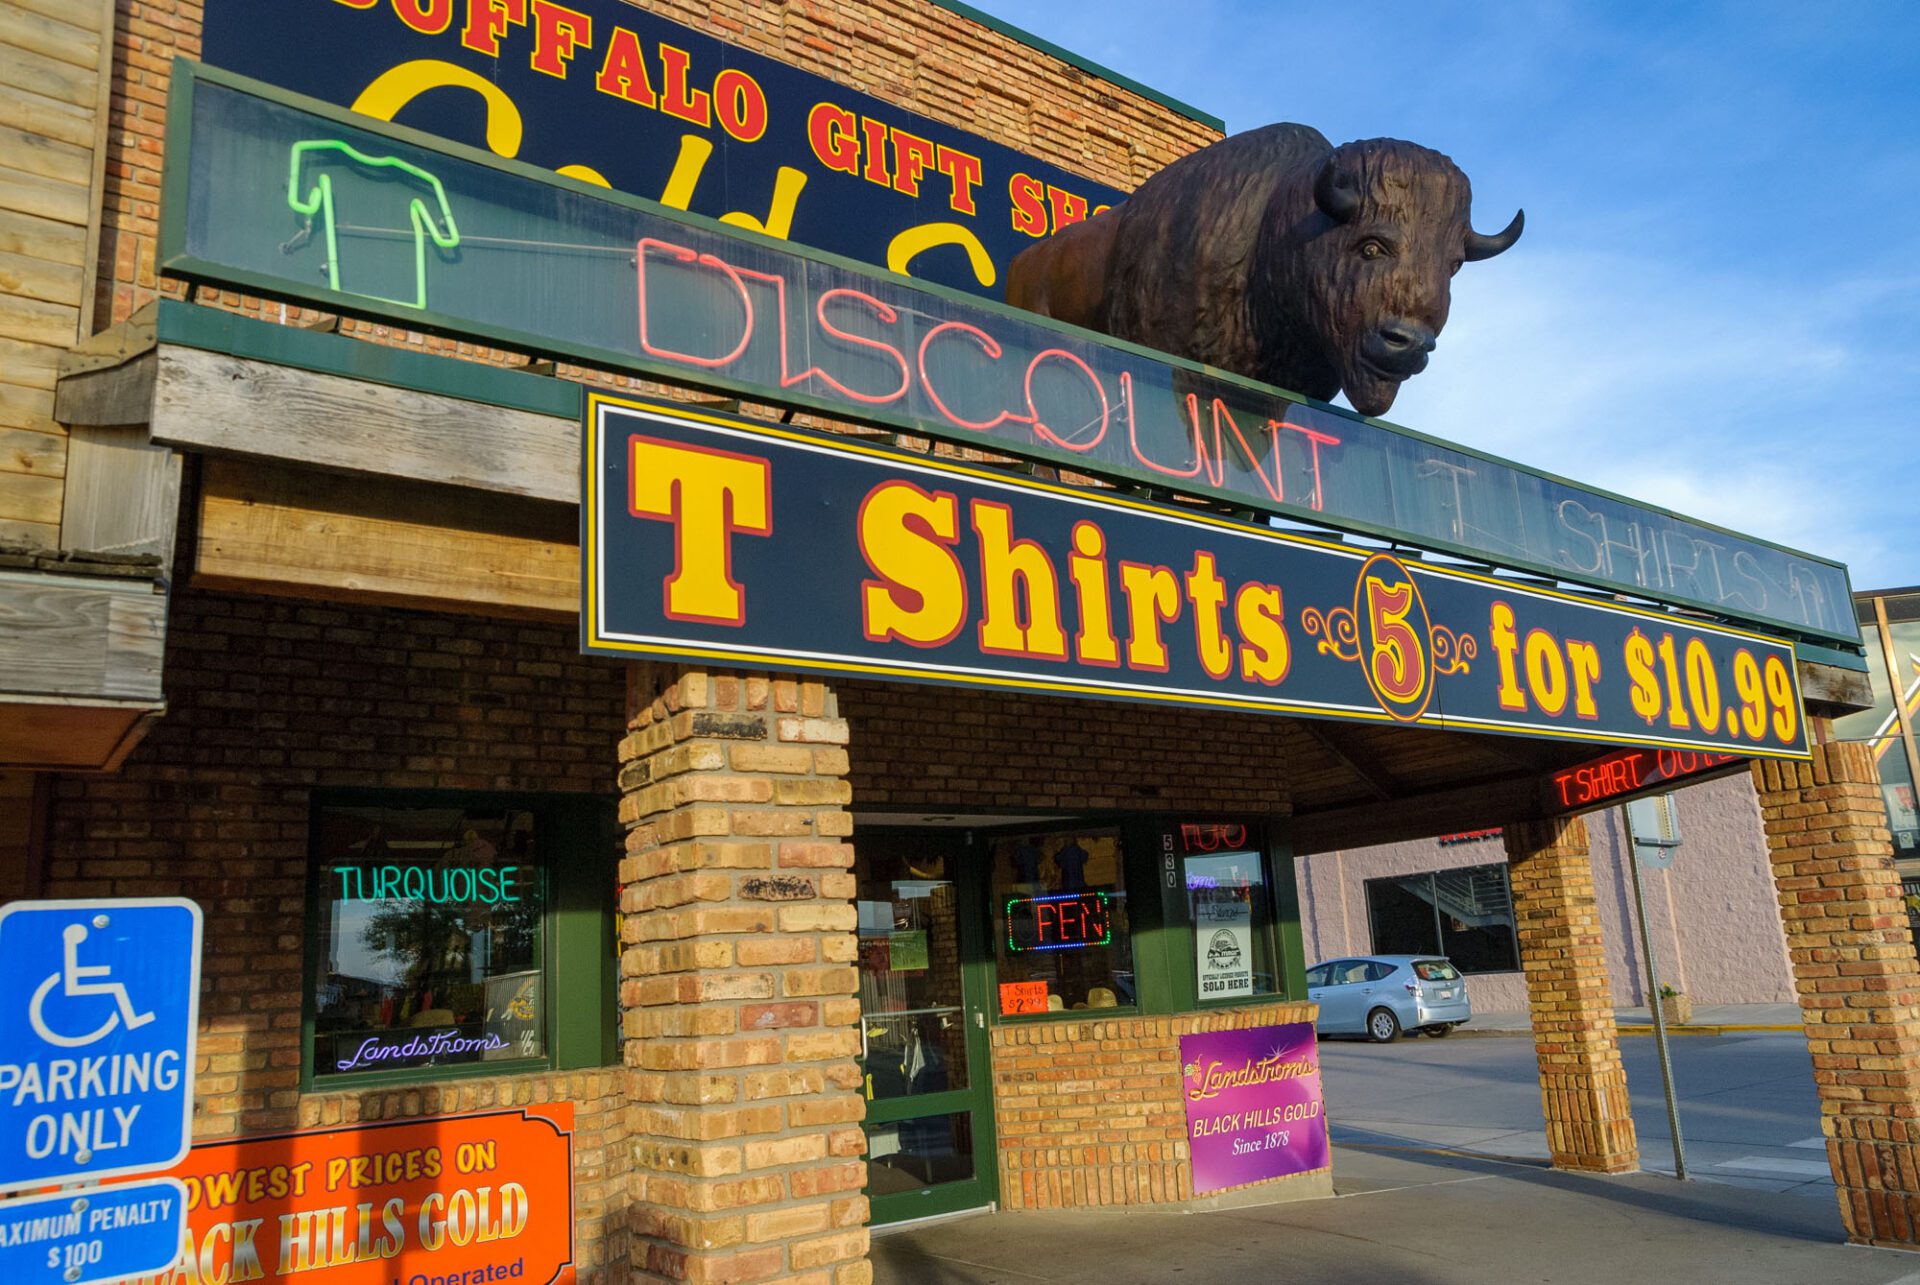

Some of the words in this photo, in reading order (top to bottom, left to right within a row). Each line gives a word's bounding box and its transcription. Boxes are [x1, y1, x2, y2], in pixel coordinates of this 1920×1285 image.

[333, 0, 769, 143] FFALO
[807, 101, 983, 216] GIFT
[1009, 171, 1114, 238] SH
[637, 237, 1342, 512] DISCOUNT
[1417, 459, 1477, 541] T
[1556, 499, 1768, 612] SHIRTS
[628, 433, 772, 628] T
[857, 479, 1291, 687] Shirts
[1366, 575, 1425, 705] 5
[1491, 600, 1601, 721] for
[1623, 626, 1797, 745] $10.99
[1556, 775, 1572, 806] T
[1576, 753, 1643, 802] SHIRT
[334, 865, 521, 904] TURQUOISE
[1203, 980, 1225, 992] SOLD
[1227, 978, 1249, 990] HERE
[0, 1049, 180, 1106] PARKING
[26, 1104, 142, 1159] ONLY
[1193, 1113, 1241, 1138] BLACK
[1243, 1106, 1281, 1131] HILLS
[1283, 1101, 1319, 1122] GOLD
[1232, 1138, 1262, 1156] Since
[1264, 1130, 1290, 1149] 1878
[184, 1159, 312, 1212] OWEST
[327, 1146, 442, 1193] PRICES
[456, 1139, 497, 1176] ON
[0, 1212, 83, 1248] AXIMUM
[89, 1198, 172, 1234] PENALTY
[276, 1198, 405, 1276] HILLS
[418, 1181, 529, 1252] GOLD
